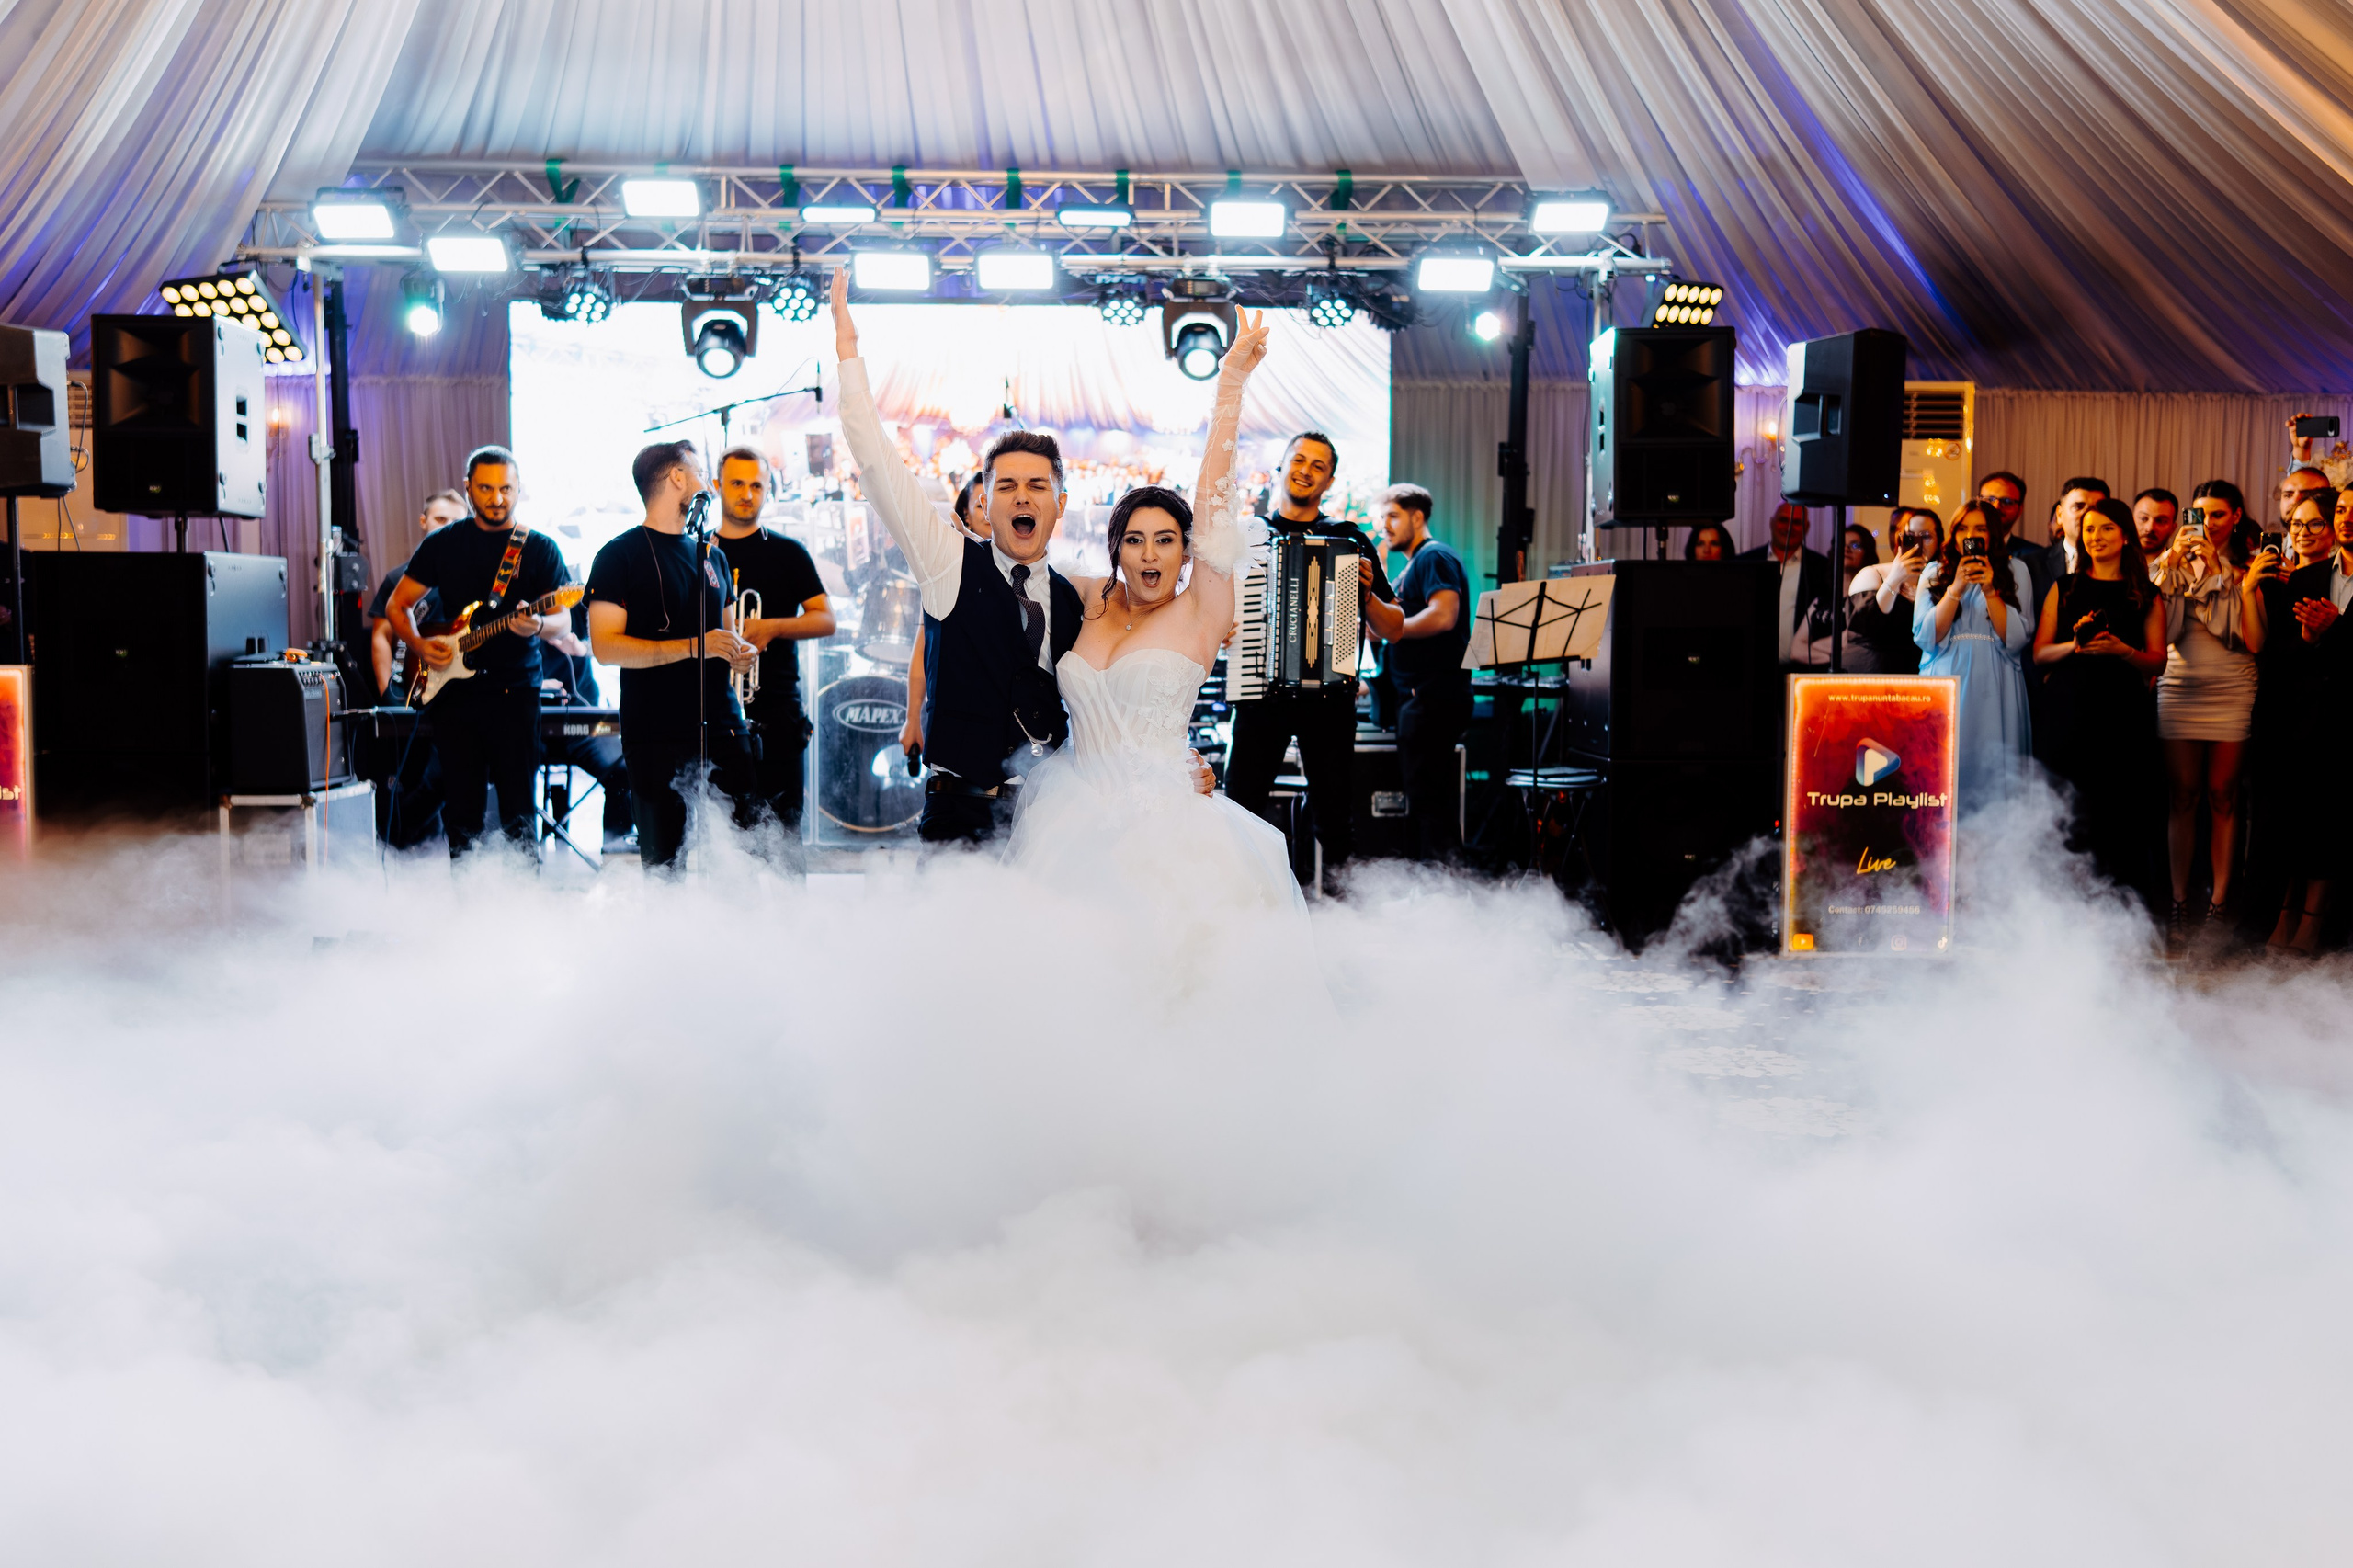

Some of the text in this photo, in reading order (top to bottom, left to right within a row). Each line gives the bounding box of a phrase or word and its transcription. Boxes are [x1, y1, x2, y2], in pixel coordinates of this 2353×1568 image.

[1289, 578, 1300, 643] CRUCIANELLI
[1828, 694, 1931, 704] www.trupanuntabacau.ro
[846, 705, 903, 724] MAPEX
[563, 724, 590, 736] KORG
[1807, 791, 1948, 810] Trupa Playlist
[1857, 846, 1897, 875] Live
